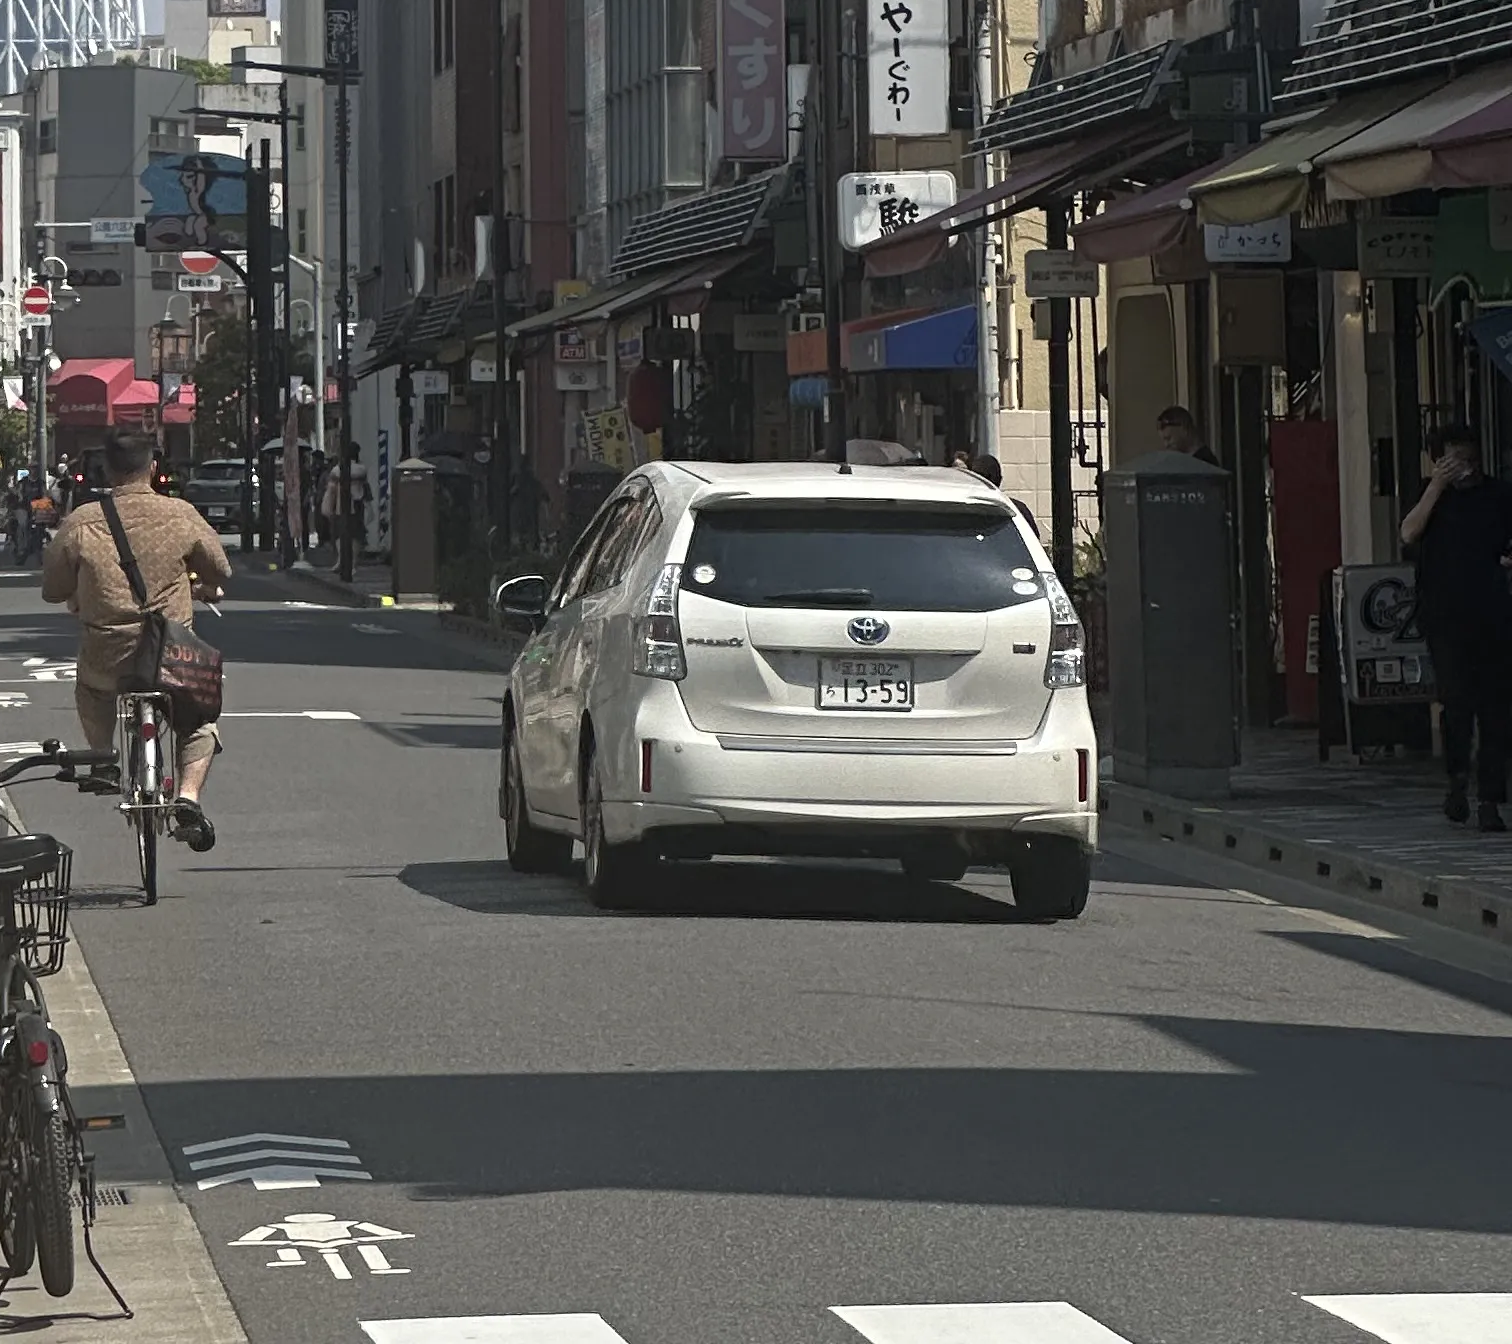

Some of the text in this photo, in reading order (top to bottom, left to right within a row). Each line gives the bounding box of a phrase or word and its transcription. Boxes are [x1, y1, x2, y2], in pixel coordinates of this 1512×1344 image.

[855, 182, 896, 196] 西浅草
[561, 347, 586, 359] ATM
[843, 678, 908, 703] 13-59
